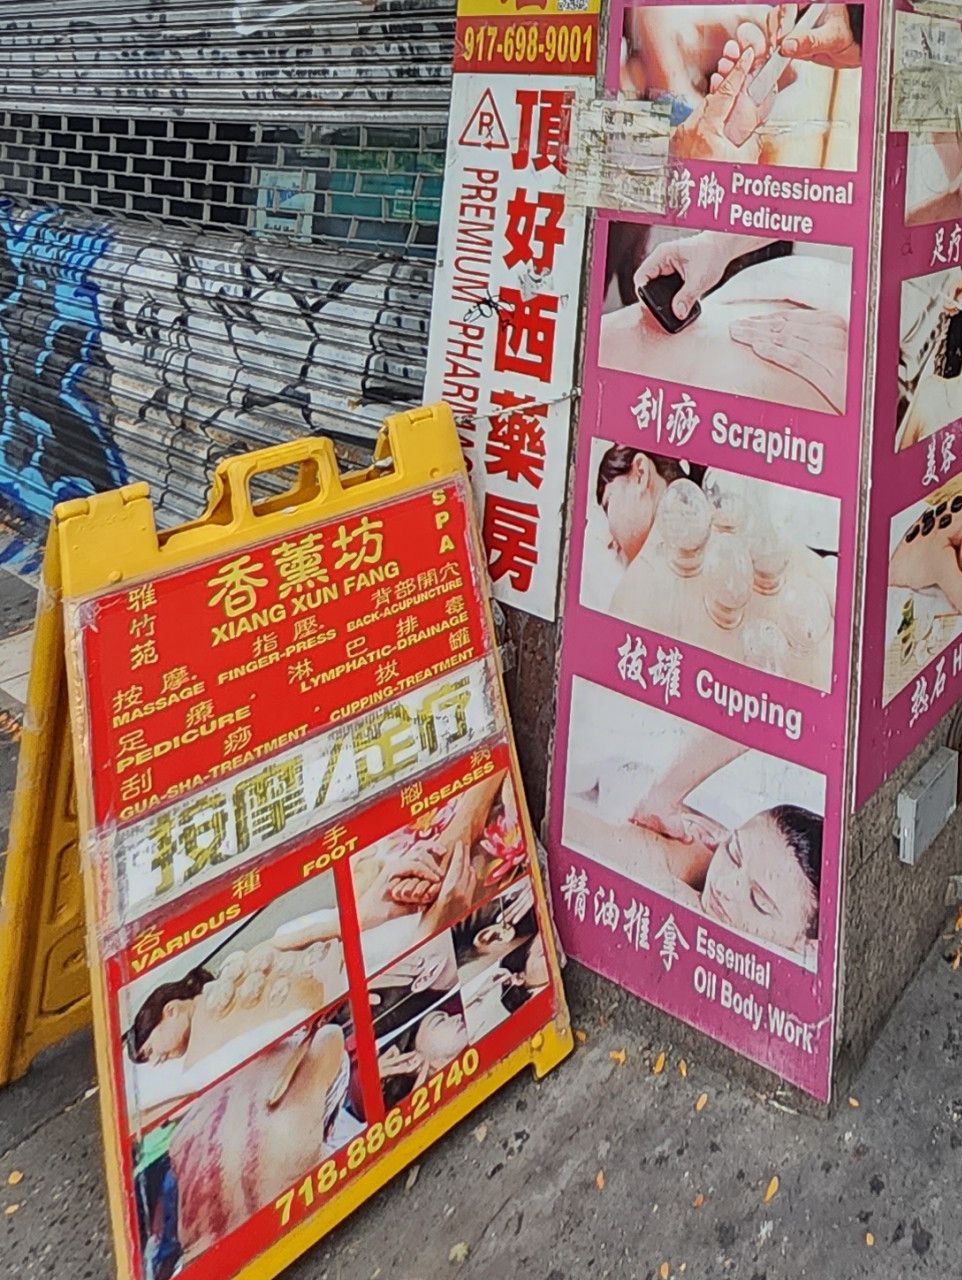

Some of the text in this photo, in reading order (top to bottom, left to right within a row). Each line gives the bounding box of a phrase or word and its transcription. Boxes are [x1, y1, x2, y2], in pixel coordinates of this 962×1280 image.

[463, 24, 593, 64] 917-698-9001
[729, 204, 814, 234] Pedicure
[731, 171, 854, 206] Professional
[452, 166, 500, 304] PREMIUM
[930, 222, 961, 268] 足疗
[629, 387, 700, 447] 刮痧
[710, 411, 825, 476] Scraping
[921, 433, 957, 486] 美容
[206, 515, 384, 618] 香薰坊
[126, 581, 160, 671] 雅竹苑
[209, 559, 400, 648] XIANG XUN FANG
[346, 577, 463, 634] BACK-ACUPUNCTURE
[217, 628, 337, 686] FINGER-PRESS
[299, 610, 469, 694] LYMPHATIC-DRAINAGE
[330, 647, 476, 722] CUPPING-TREATMENT
[616, 632, 684, 706] 拔罐
[111, 680, 206, 729] MASSAGE
[695, 668, 803, 741] Cupping
[909, 655, 947, 728] 热石
[116, 704, 252, 775] PEDICURE
[119, 724, 309, 821] GUA-SHA-TREATMENT
[131, 760, 496, 974] VARIOUS FOOT DISEASES
[559, 864, 690, 974] 精油推拿
[696, 926, 772, 991] Essential
[693, 964, 815, 1055] Oil Body Work
[274, 1047, 480, 1228] 718.886.2740
